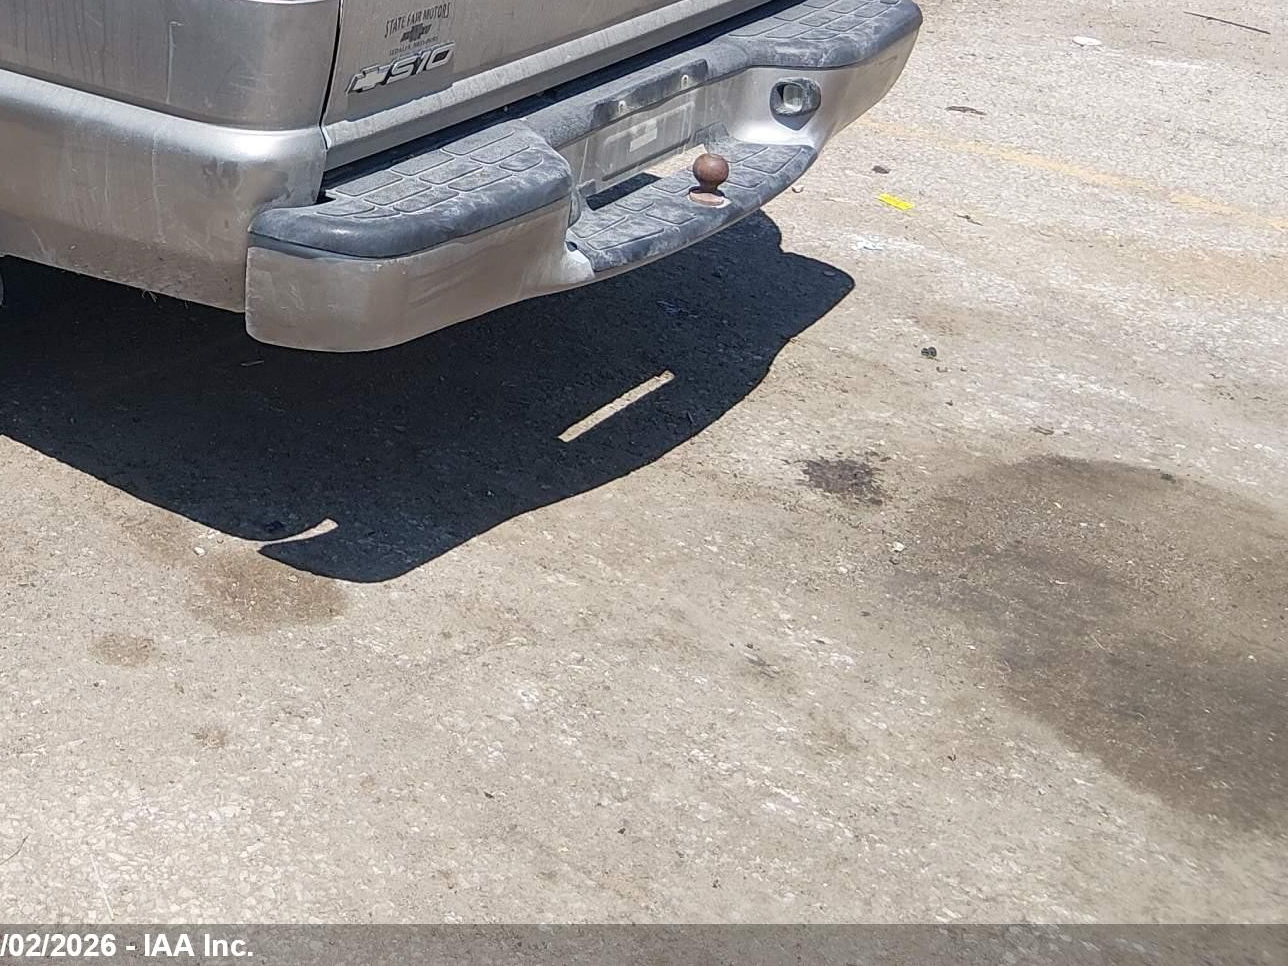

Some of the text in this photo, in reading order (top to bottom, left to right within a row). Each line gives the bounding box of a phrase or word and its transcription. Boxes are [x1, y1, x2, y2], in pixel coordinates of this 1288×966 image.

[384, 16, 405, 38] STATE
[423, 1, 451, 20] MOTORS
[386, 41, 455, 85] S10
